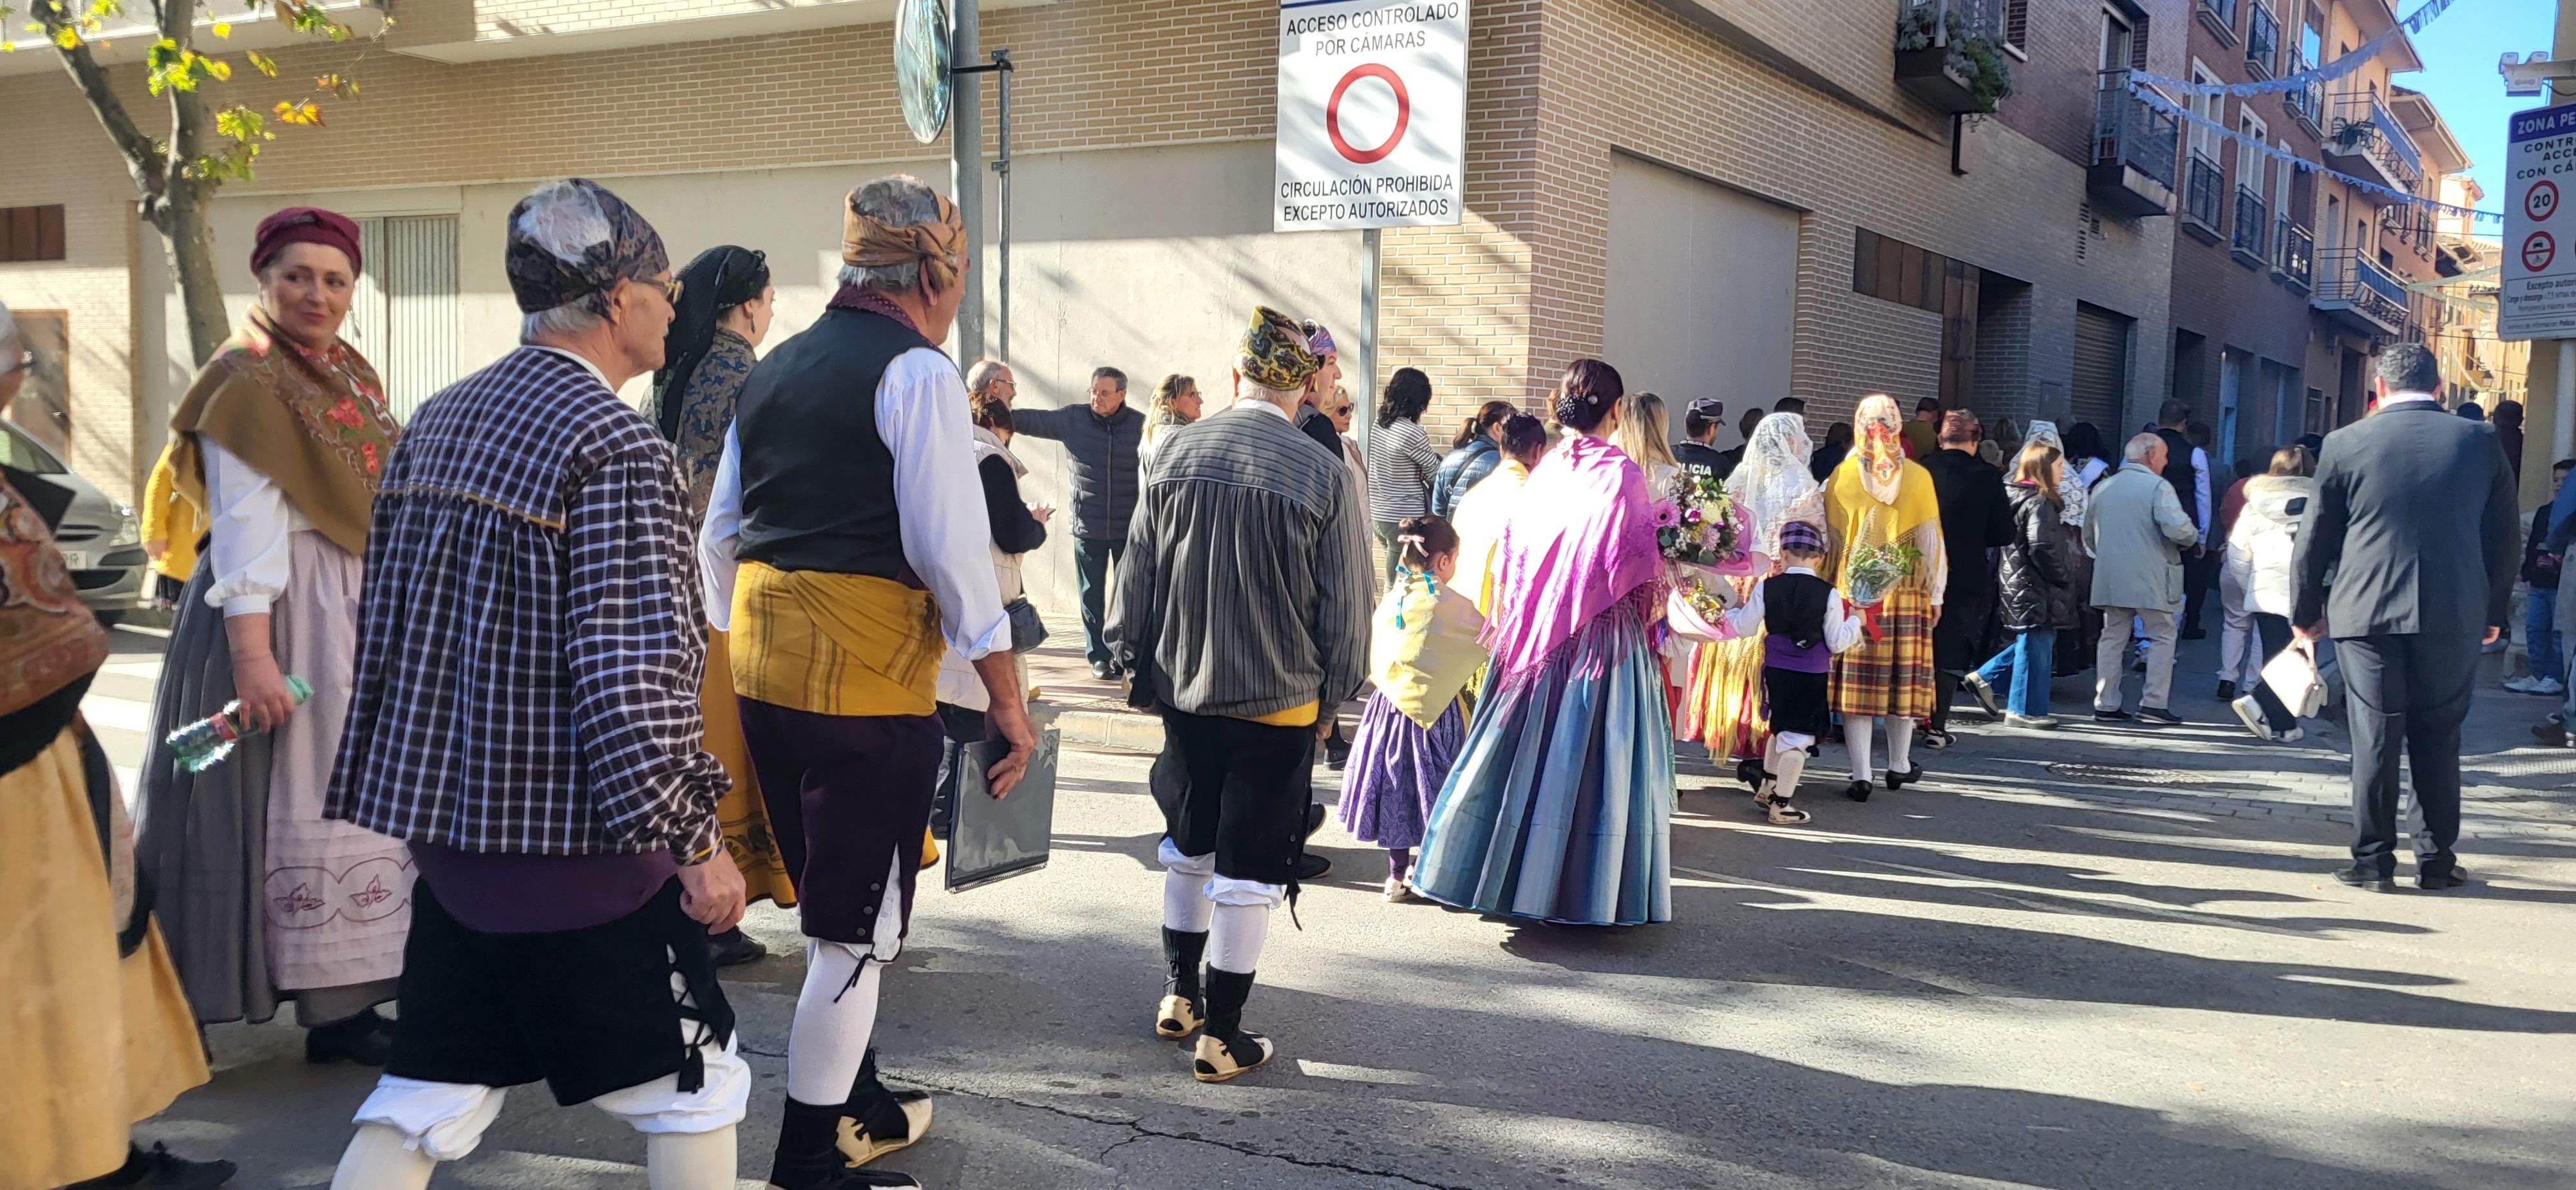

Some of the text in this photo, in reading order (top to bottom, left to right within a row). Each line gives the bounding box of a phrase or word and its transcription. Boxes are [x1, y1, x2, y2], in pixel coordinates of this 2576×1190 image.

[1287, 3, 1459, 36] ACCESO CONTROLADO
[1316, 30, 1425, 56] POR CÁMARAS
[2517, 116, 2555, 135] ZONA
[2524, 137, 2576, 153] CONTR
[2517, 160, 2576, 180] CON CÁ
[1281, 175, 1453, 198] CIRCULACIÓN PROHIBIDA
[1283, 199, 1448, 222] EXCEPTO AUTORIZADOS
[2533, 194, 2550, 208] 20
[2526, 281, 2553, 290] Excepto
[1676, 462, 1712, 476] LICIA
